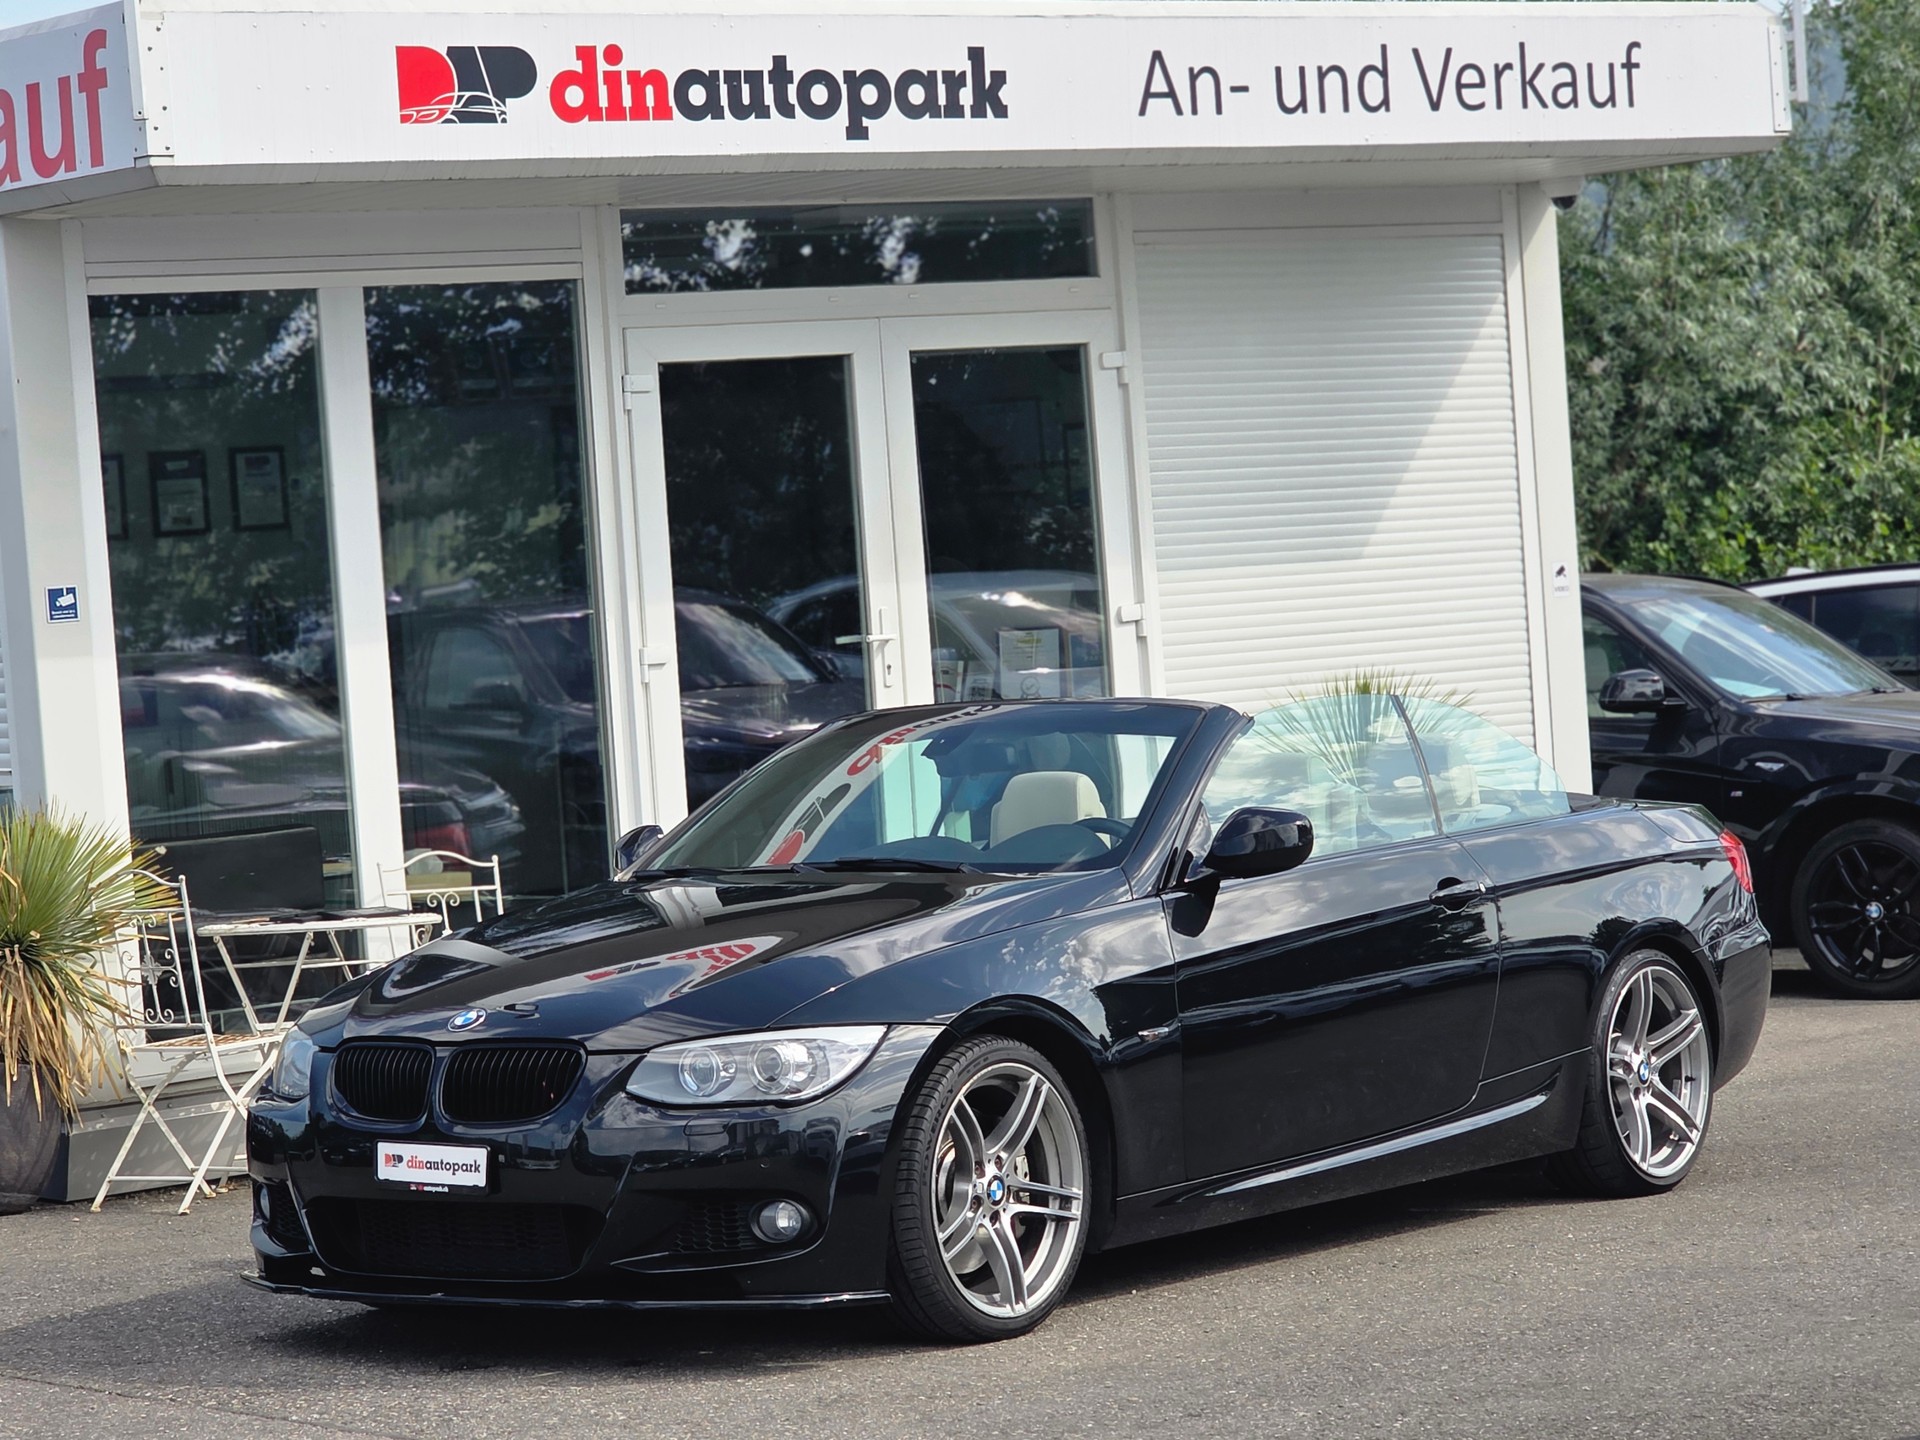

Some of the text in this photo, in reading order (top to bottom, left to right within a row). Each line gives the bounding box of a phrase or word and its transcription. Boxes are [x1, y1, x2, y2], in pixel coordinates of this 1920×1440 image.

[549, 43, 1008, 140] dinautopark
[1139, 41, 1641, 116] An- und Verkauf
[406, 1155, 481, 1176] dinautopark
